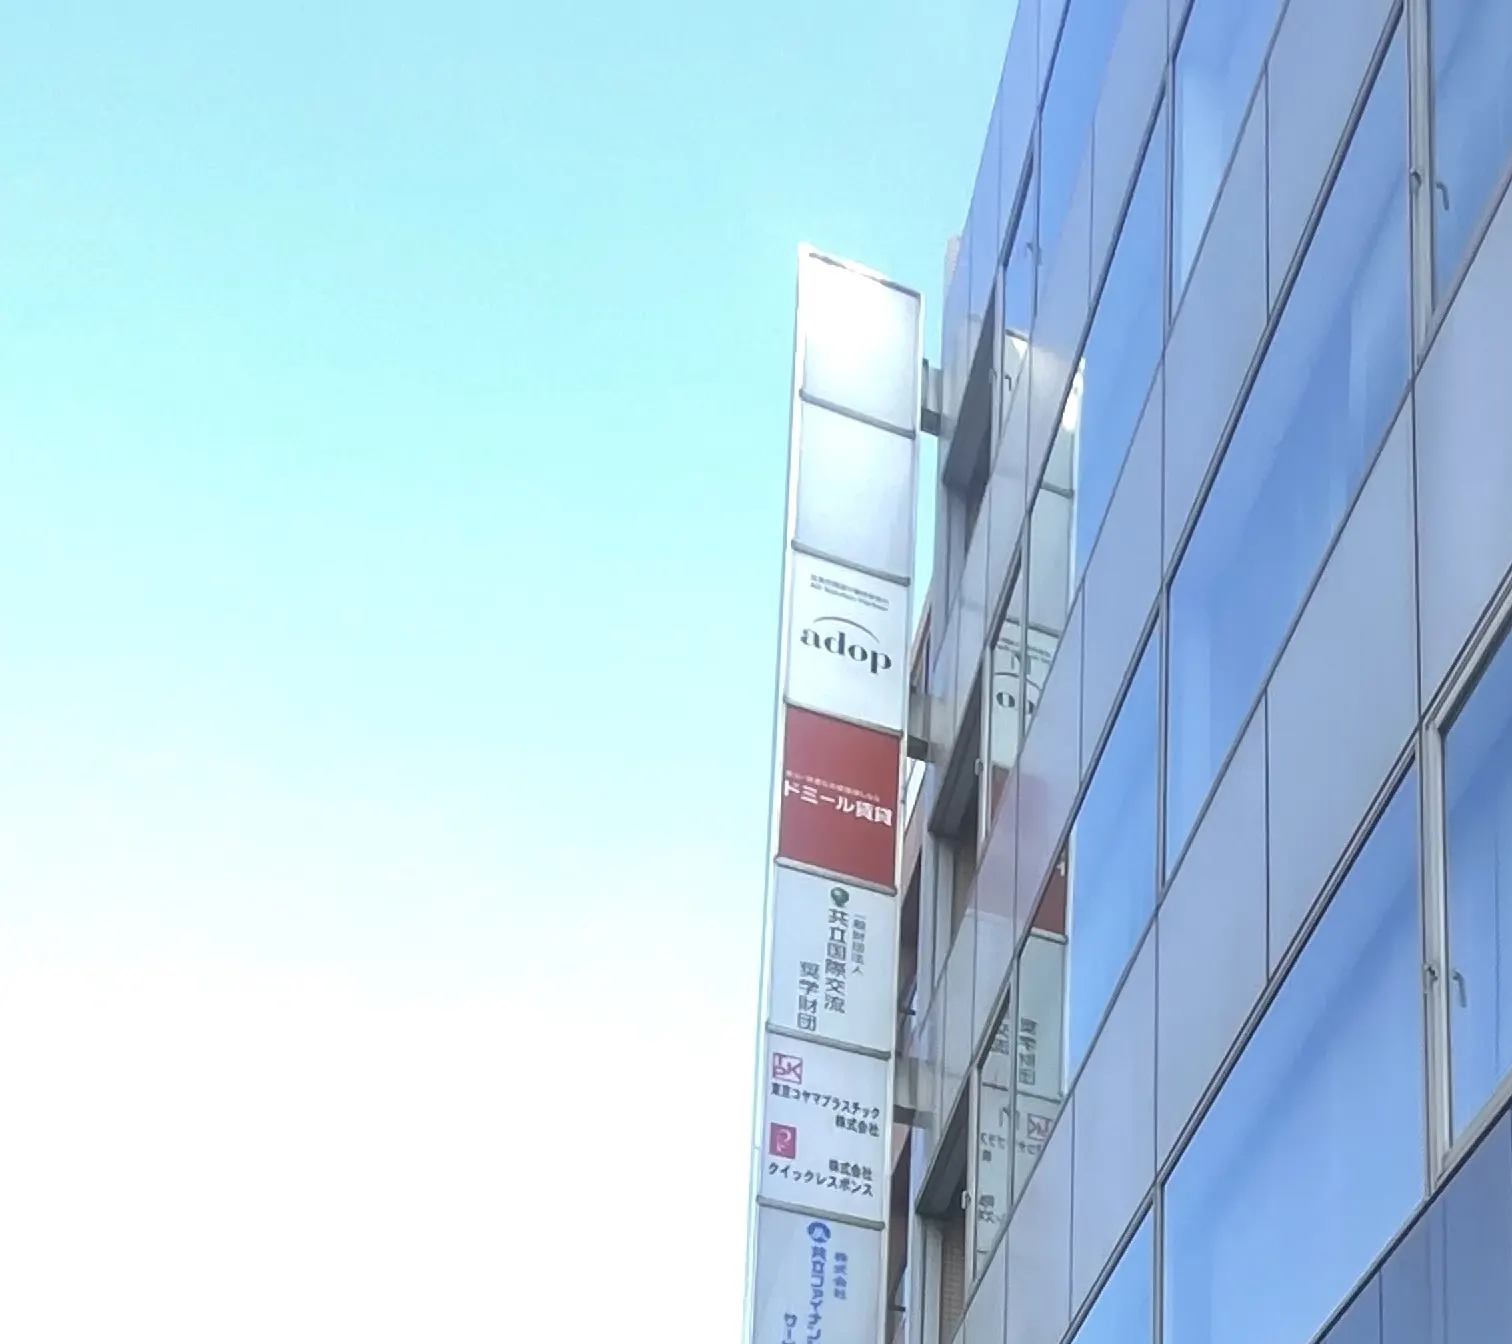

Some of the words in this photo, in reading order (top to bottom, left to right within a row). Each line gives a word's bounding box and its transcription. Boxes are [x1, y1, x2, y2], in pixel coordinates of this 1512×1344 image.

[800, 628, 892, 675] adop
[824, 908, 848, 1013] 共立国際交流
[835, 1114, 879, 1137] 株式会社
[769, 1162, 873, 1197] クイックレスポンス
[829, 1158, 872, 1181] 株式会社
